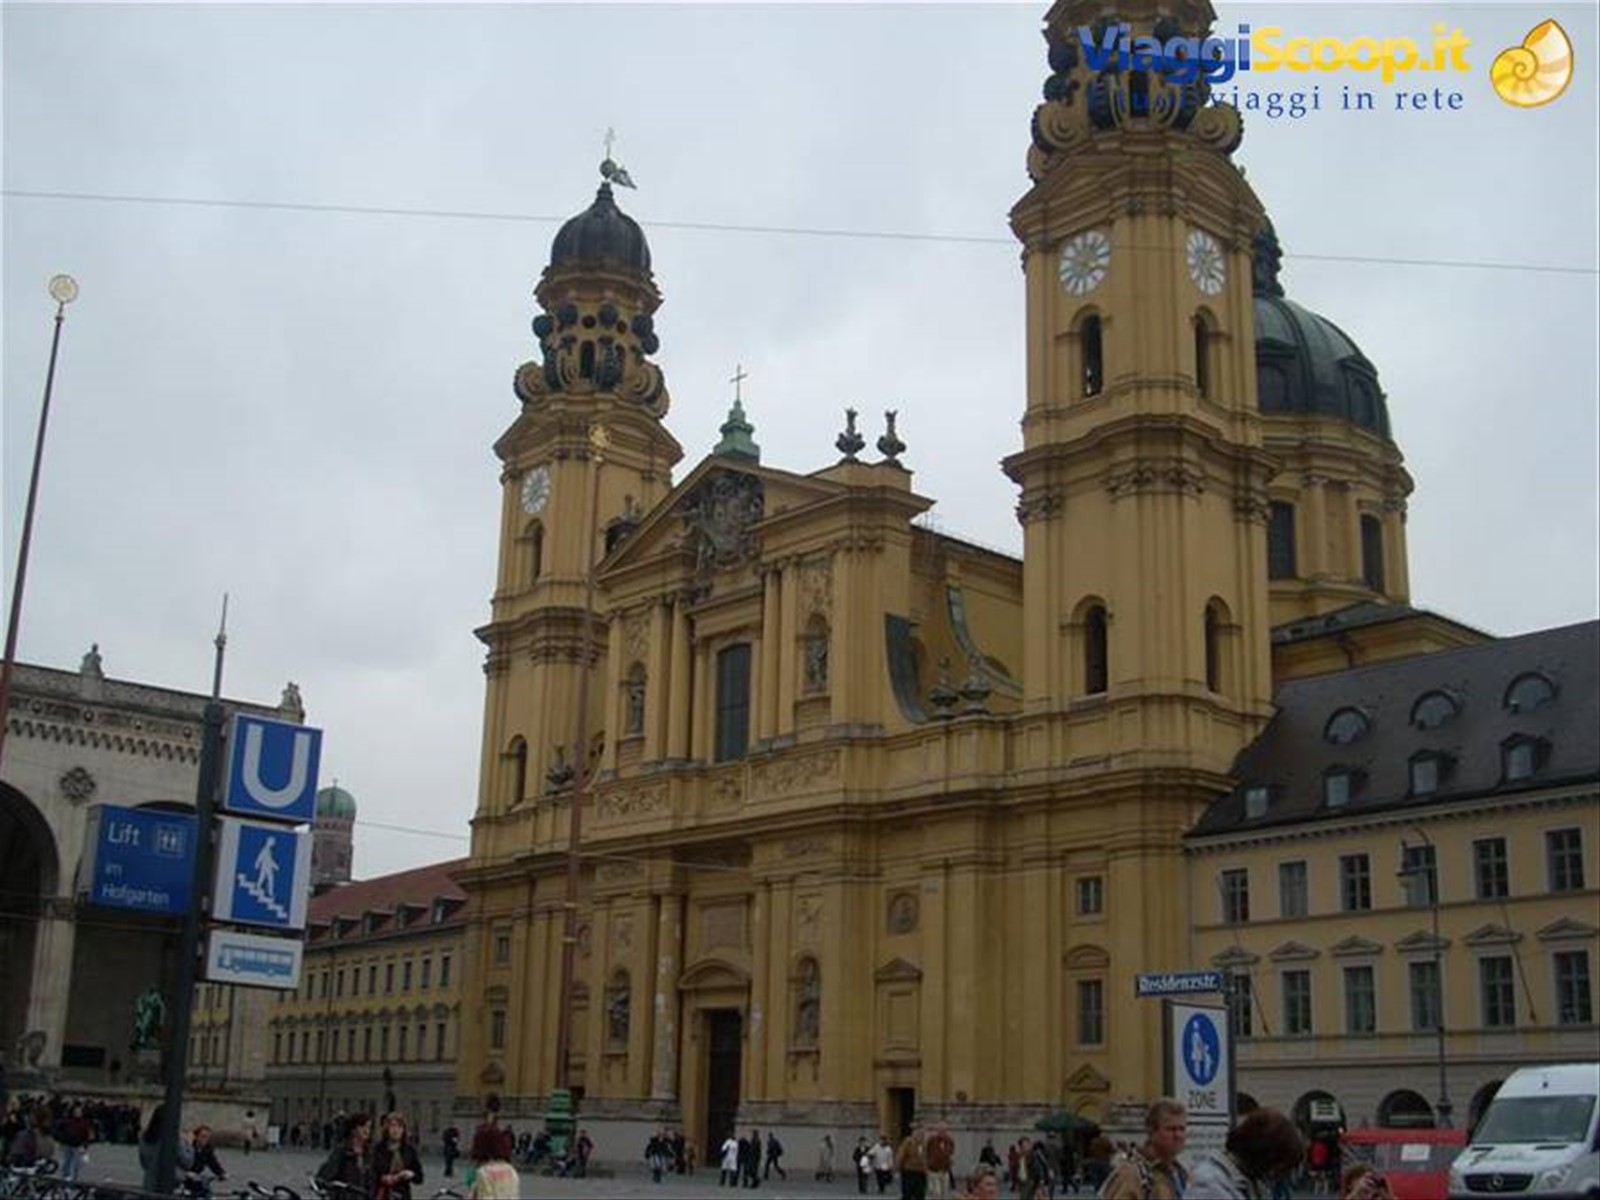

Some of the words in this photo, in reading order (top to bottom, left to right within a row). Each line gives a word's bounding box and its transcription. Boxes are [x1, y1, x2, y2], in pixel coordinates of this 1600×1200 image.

[242, 723, 313, 808] U
[108, 821, 140, 846] Lift
[102, 883, 170, 905] Hofgarten
[1188, 1090, 1217, 1109] ZONE
